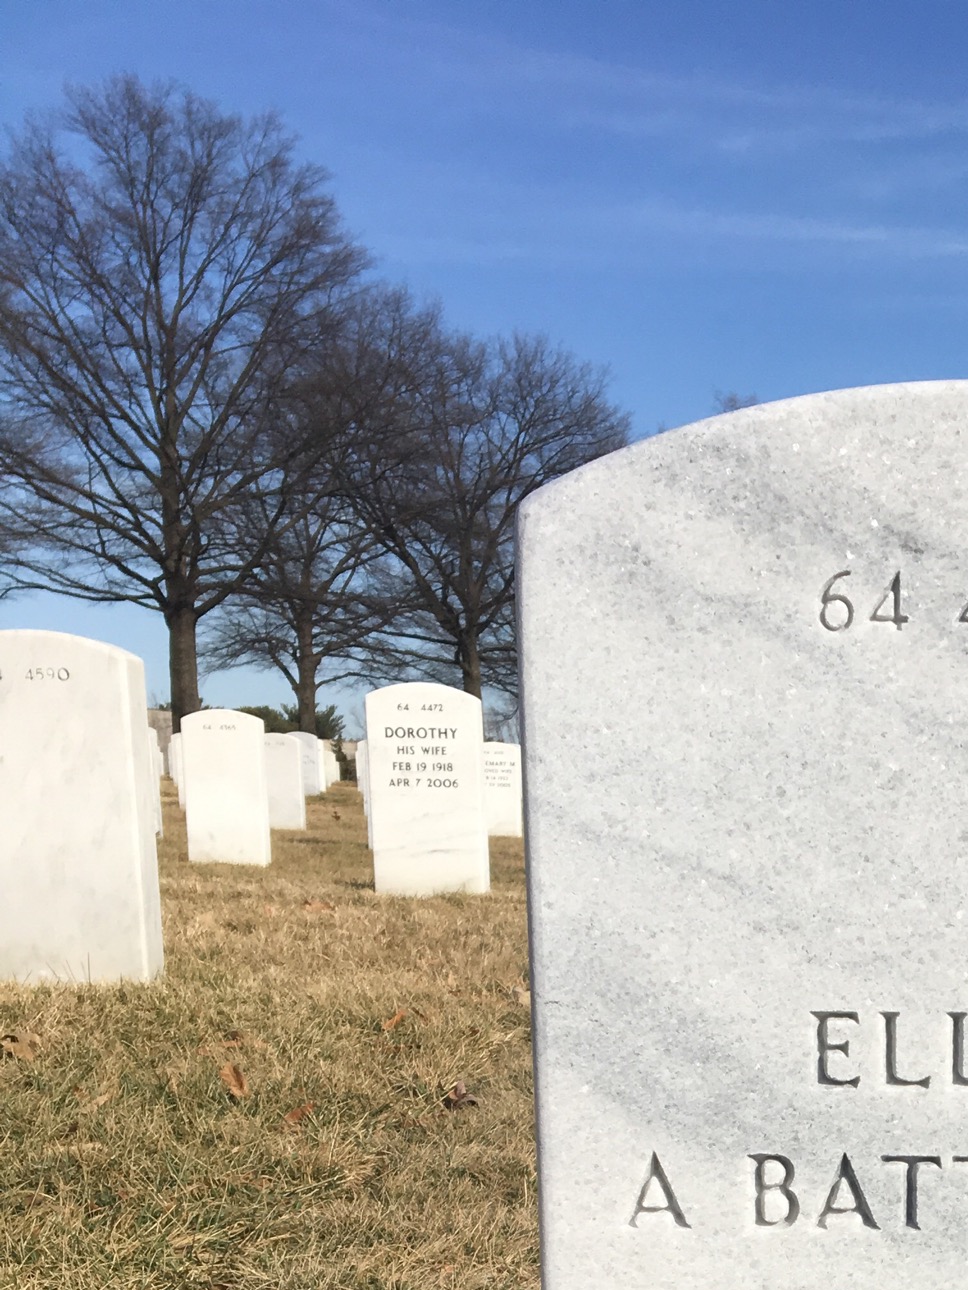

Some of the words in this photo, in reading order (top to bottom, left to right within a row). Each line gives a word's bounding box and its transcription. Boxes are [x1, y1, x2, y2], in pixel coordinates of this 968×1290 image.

[819, 569, 910, 632] 64
[25, 667, 70, 681] 4590
[396, 703, 409, 711] 64
[420, 703, 443, 712] 4472
[384, 727, 458, 739] DOROTHY
[397, 746, 415, 755] HIS
[421, 746, 447, 755] WIFE
[392, 762, 411, 771] FEB
[416, 762, 426, 771] 19
[432, 762, 453, 772] 1918
[389, 778, 410, 787] APR
[415, 778, 421, 787] 7
[427, 778, 459, 788] 2006
[628, 1150, 692, 1229] A
